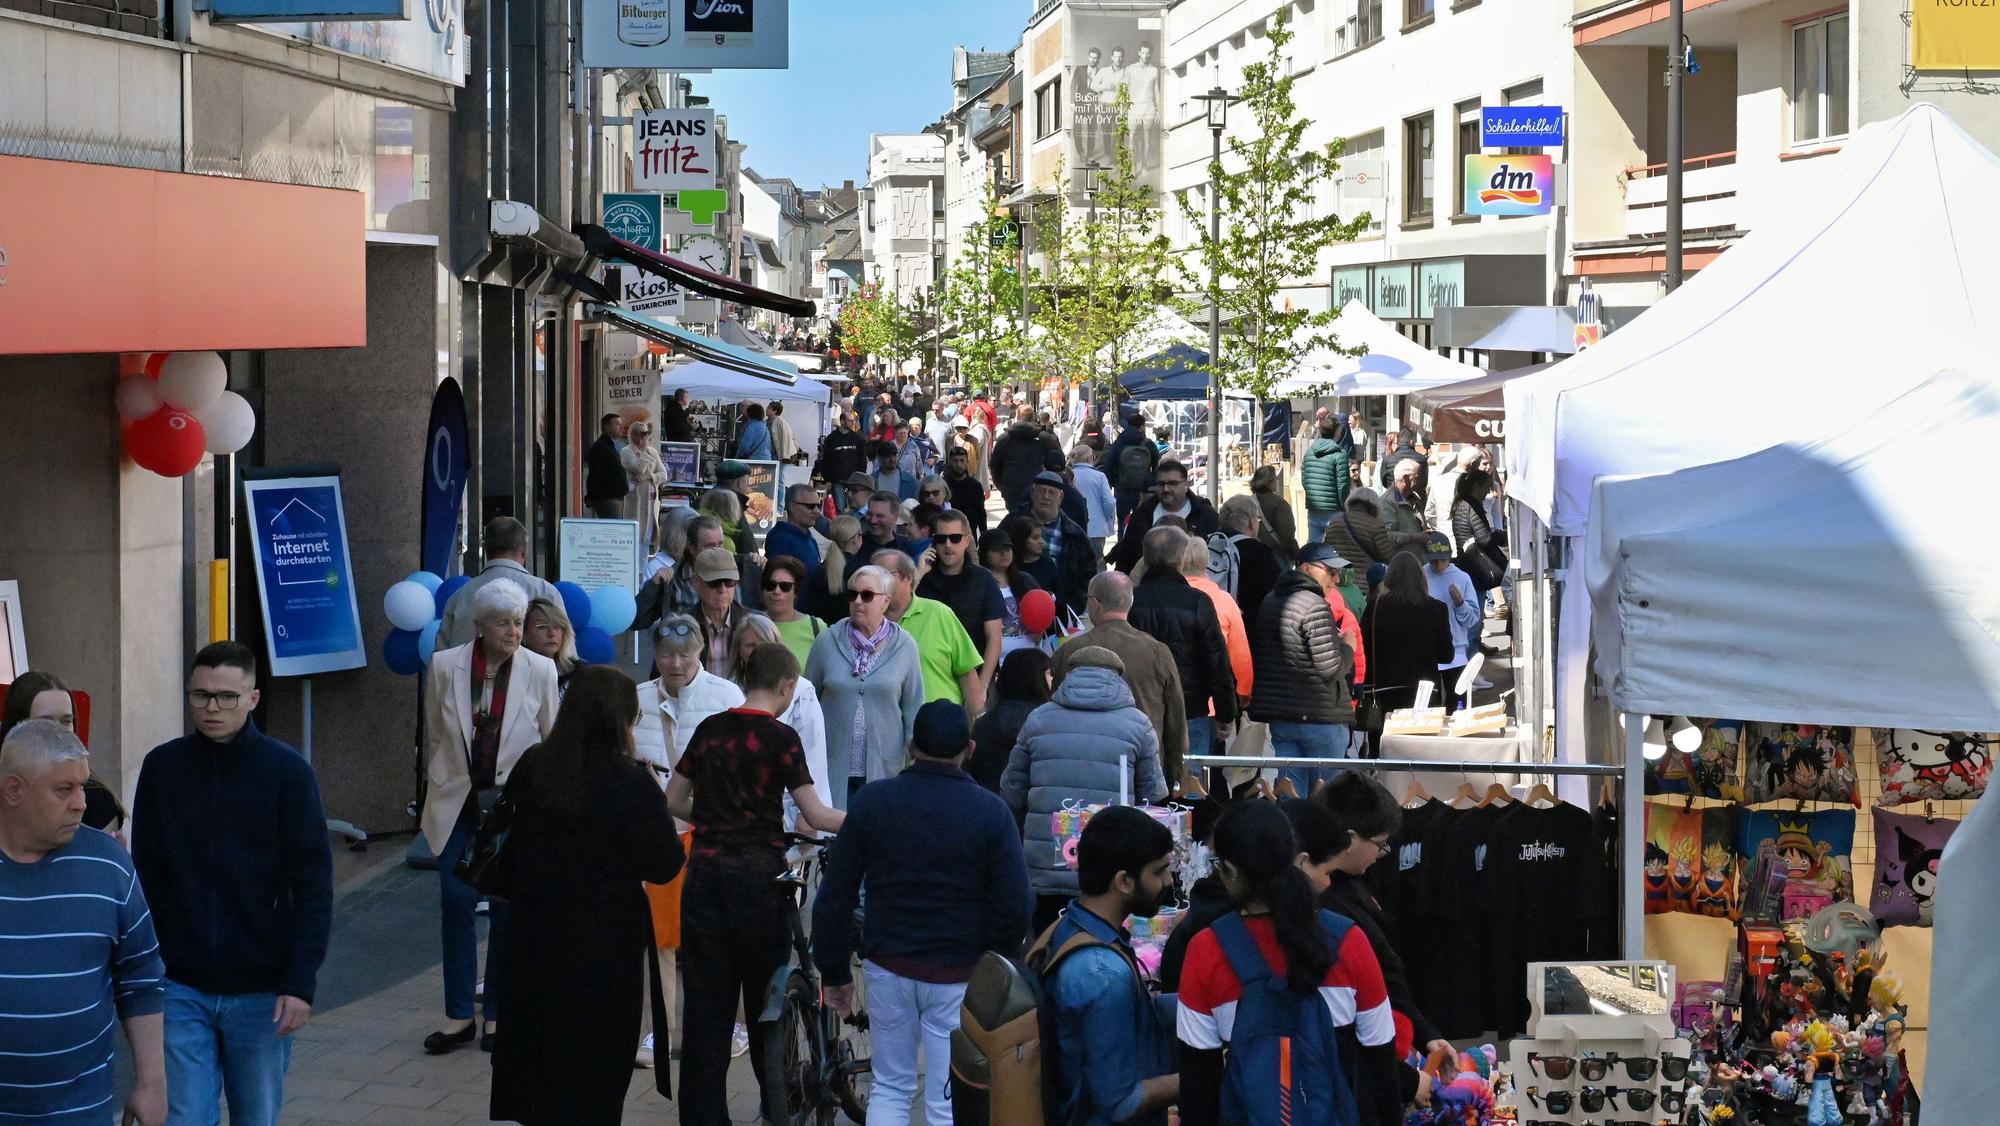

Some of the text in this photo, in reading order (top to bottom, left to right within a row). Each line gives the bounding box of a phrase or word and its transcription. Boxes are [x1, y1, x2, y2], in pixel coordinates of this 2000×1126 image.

[621, 5, 667, 20] Bitburger
[639, 119, 706, 140] JEANS
[1485, 118, 1560, 135] Schülerhilfe!
[639, 138, 709, 179] fritz
[1490, 165, 1533, 190] dm
[624, 281, 680, 301] Kiosk
[631, 299, 678, 312] EUSKIRCHEN
[1579, 281, 1595, 324] dm
[608, 374, 647, 387] DOPPELT
[609, 388, 643, 398] LECKER
[272, 533, 297, 541] Zuhause
[273, 538, 330, 556] Internet
[275, 555, 332, 566] durchstarten
